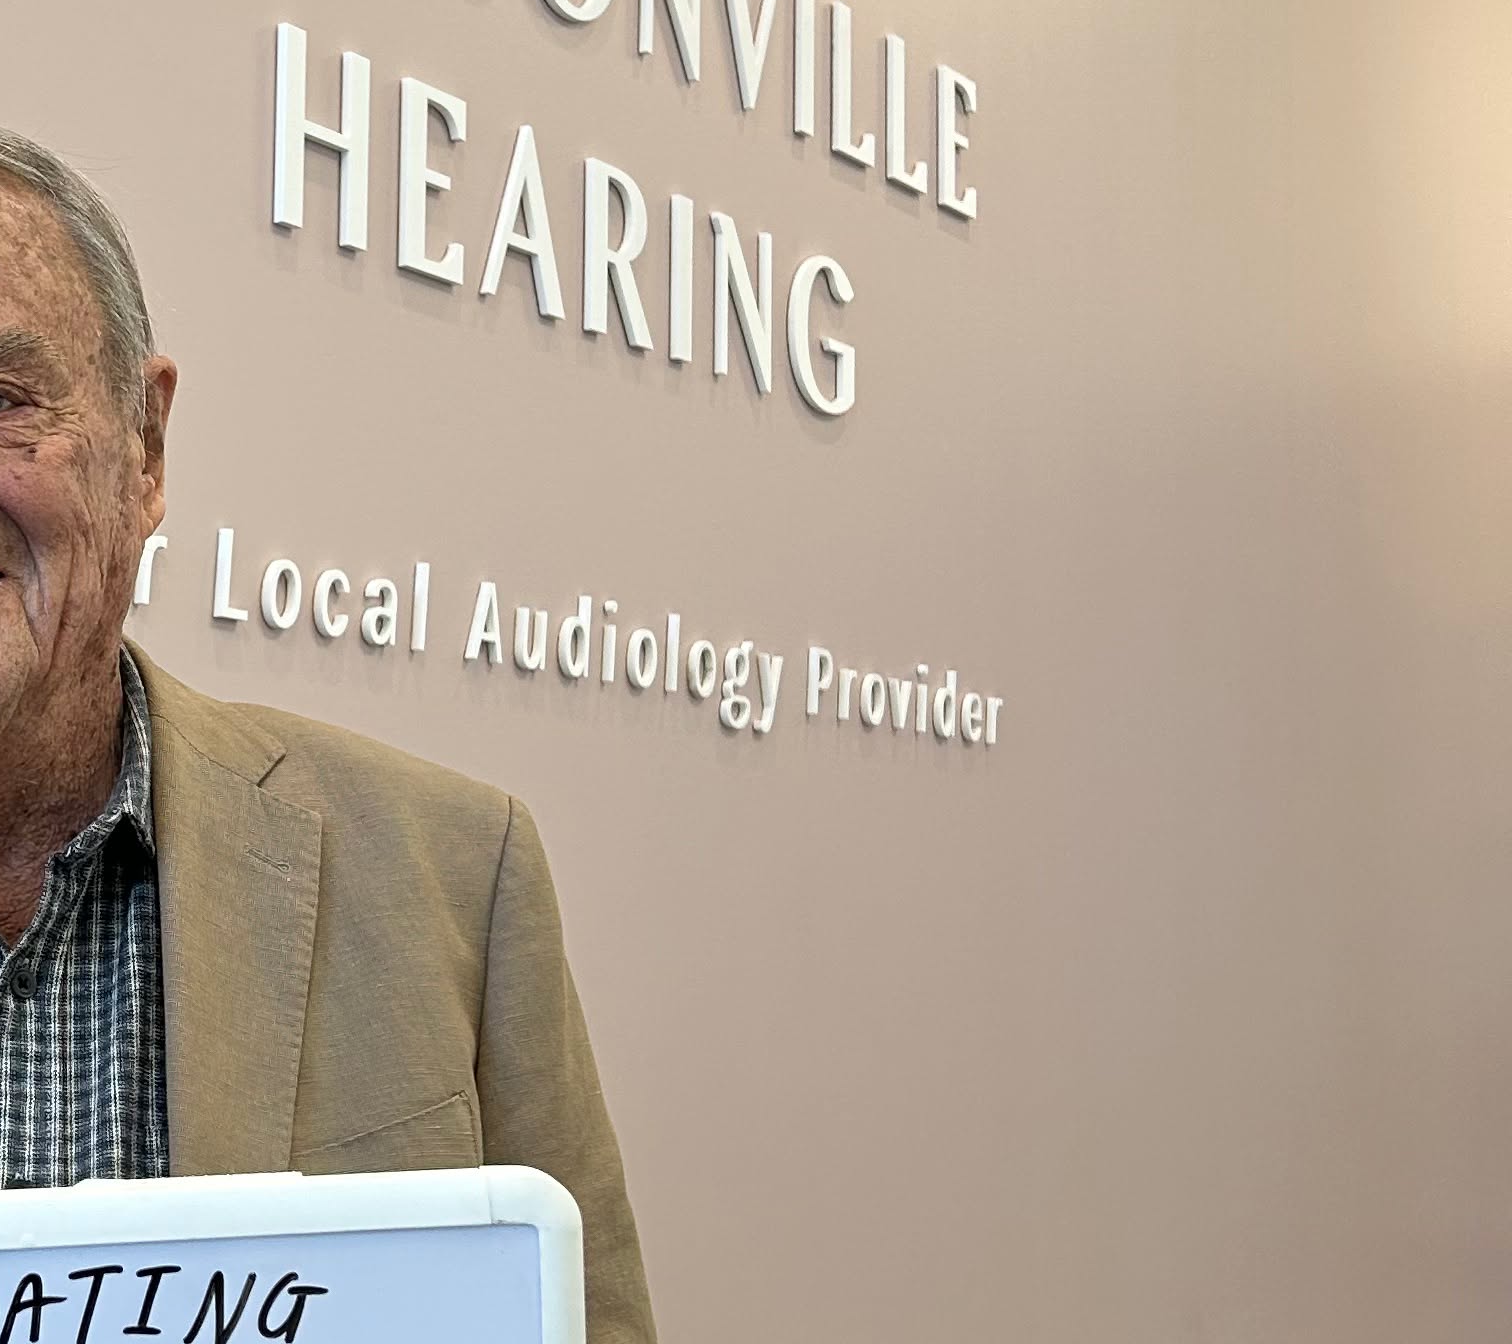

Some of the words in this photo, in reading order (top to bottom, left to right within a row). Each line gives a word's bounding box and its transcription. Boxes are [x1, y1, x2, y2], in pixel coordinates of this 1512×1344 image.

[272, 22, 856, 417] HEARING
[212, 528, 431, 653] Local
[464, 580, 784, 735] Audiology
[806, 646, 1004, 745] Provider
